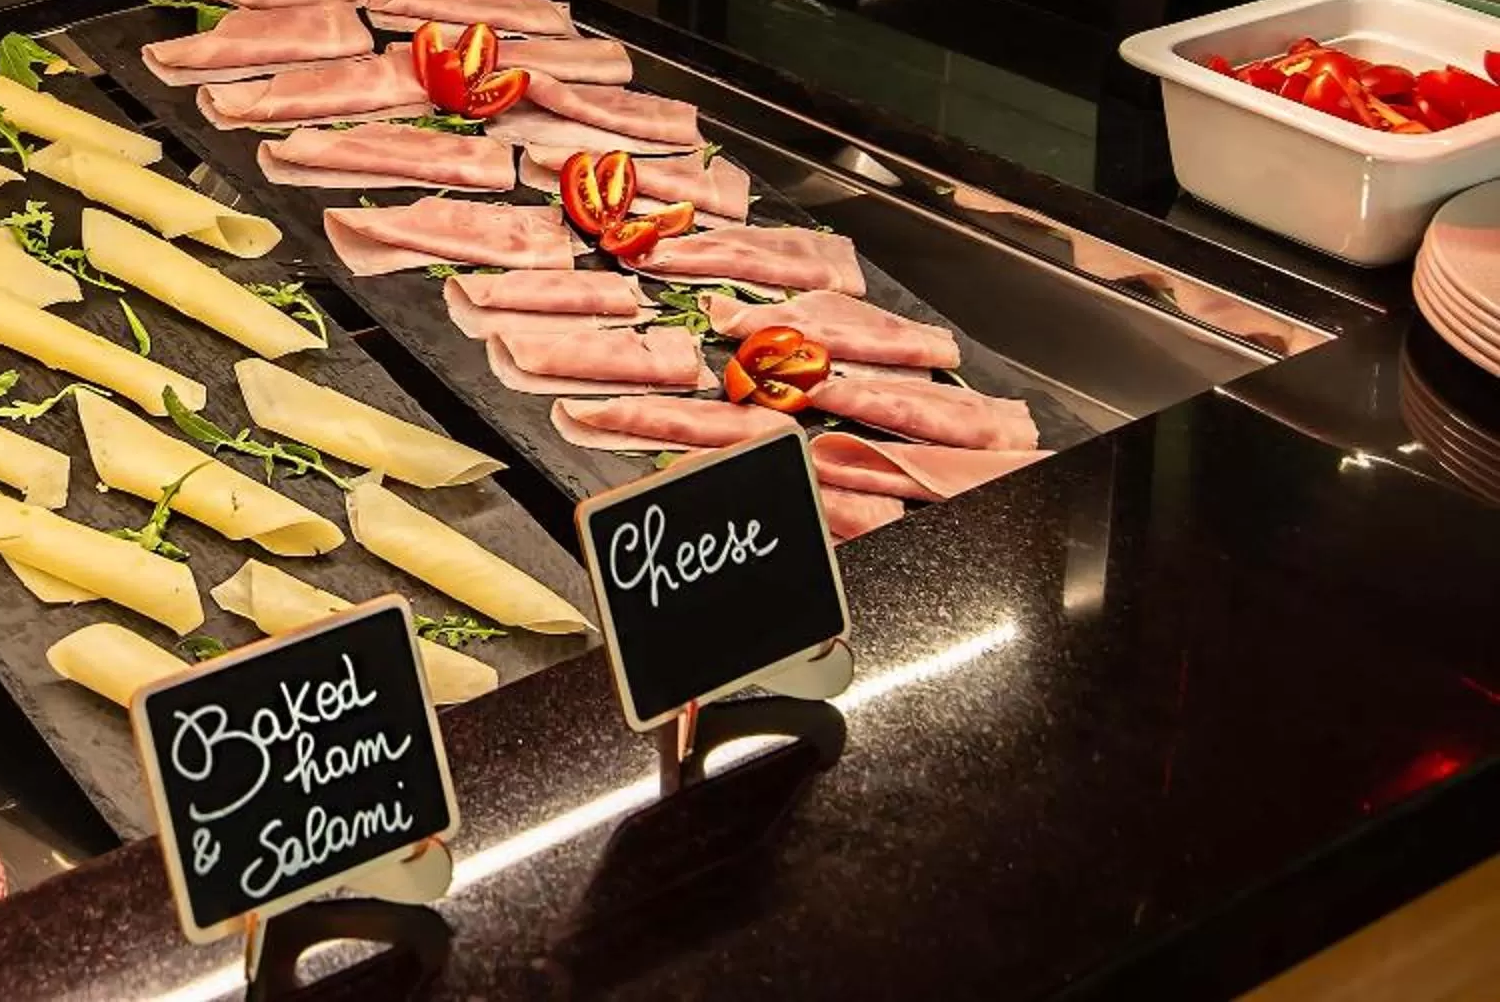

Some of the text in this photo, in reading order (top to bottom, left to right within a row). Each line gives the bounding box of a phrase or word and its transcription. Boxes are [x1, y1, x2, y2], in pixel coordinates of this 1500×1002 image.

[609, 504, 779, 607] Cheese
[172, 653, 377, 821] Baked
[283, 732, 412, 794] ham
[192, 781, 414, 898] & Salami
